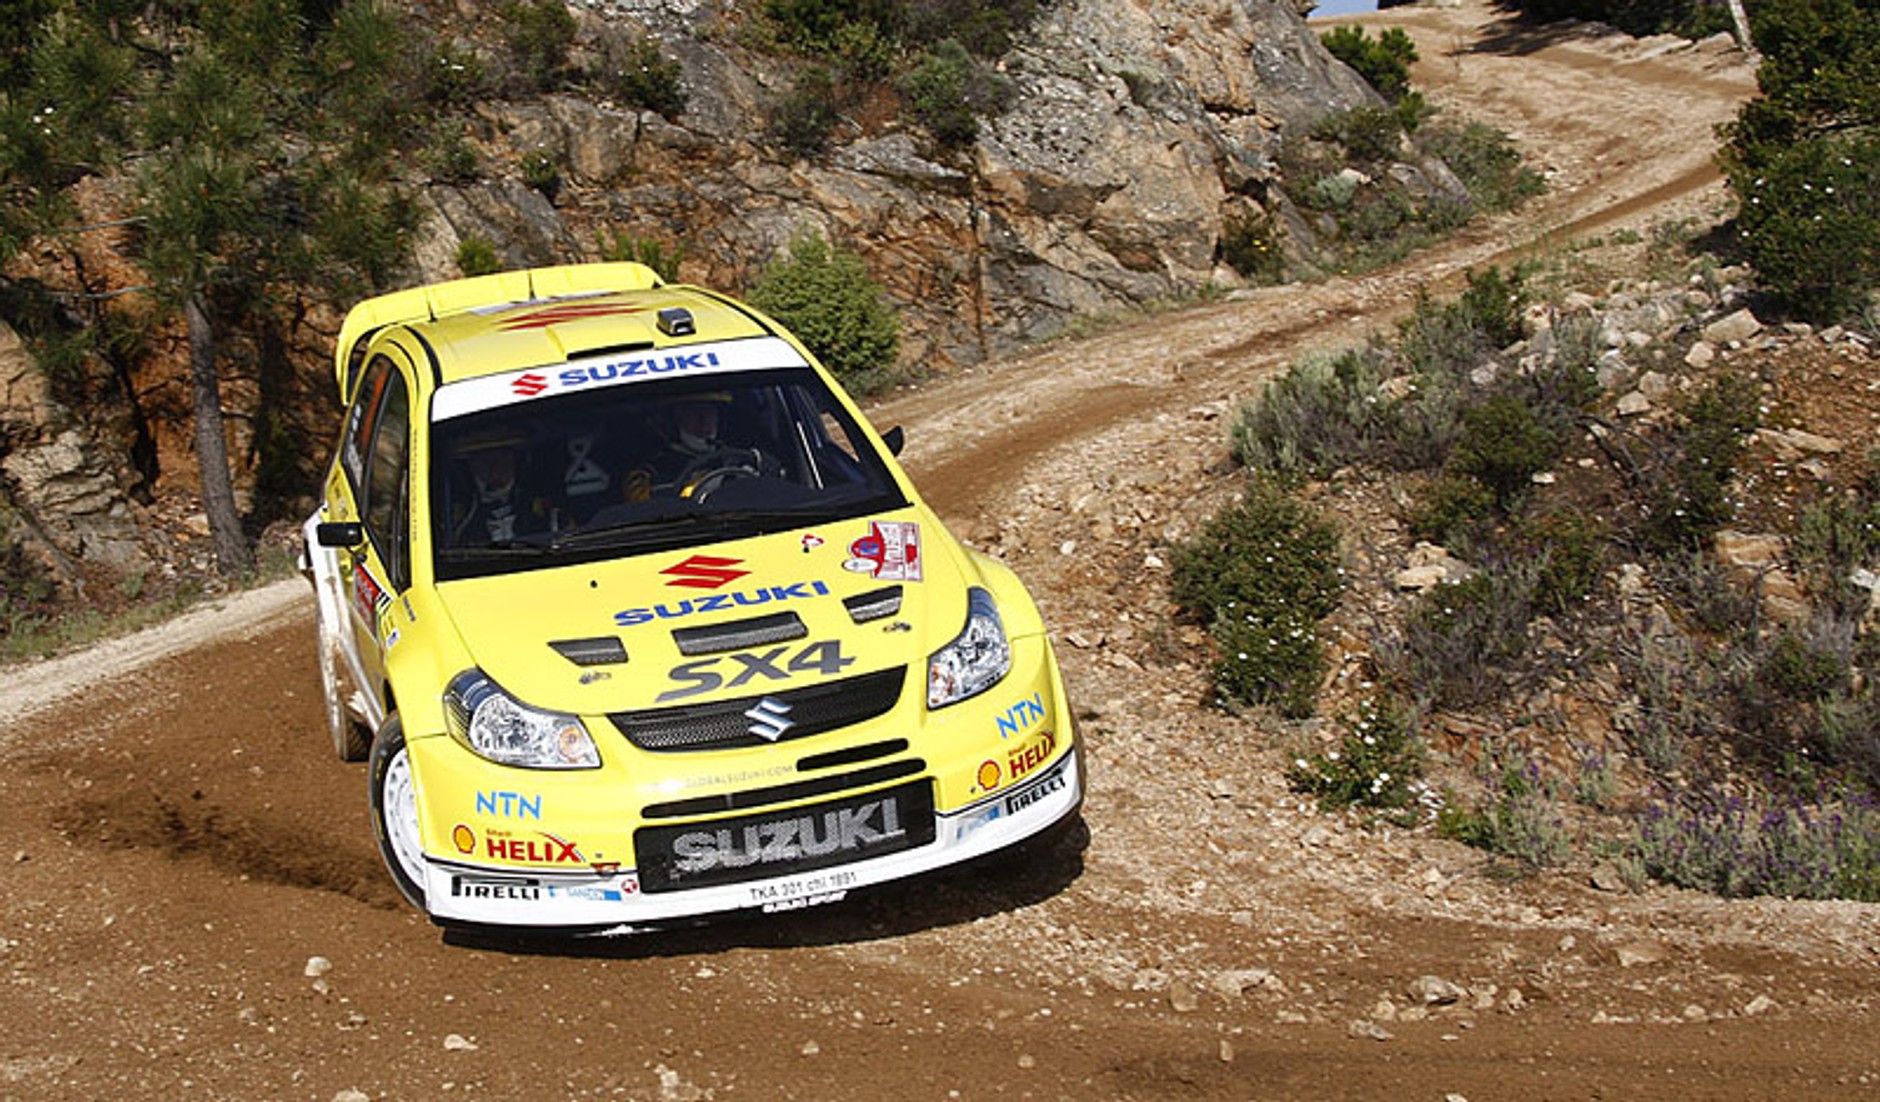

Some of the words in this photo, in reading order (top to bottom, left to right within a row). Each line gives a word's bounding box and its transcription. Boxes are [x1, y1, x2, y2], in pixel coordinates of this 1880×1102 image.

[560, 352, 718, 386] SUZUKI
[613, 580, 829, 626] SUZUKI
[655, 639, 857, 703] SX4
[995, 692, 1046, 738] NTN
[1009, 732, 1056, 778] HELIX
[476, 791, 542, 819] NTN
[1006, 768, 1066, 815] PIRELLI
[487, 833, 584, 863] HELIX
[673, 797, 906, 872] SUZUKI
[452, 875, 540, 900] PIRELLI
[749, 886, 779, 901] TKA
